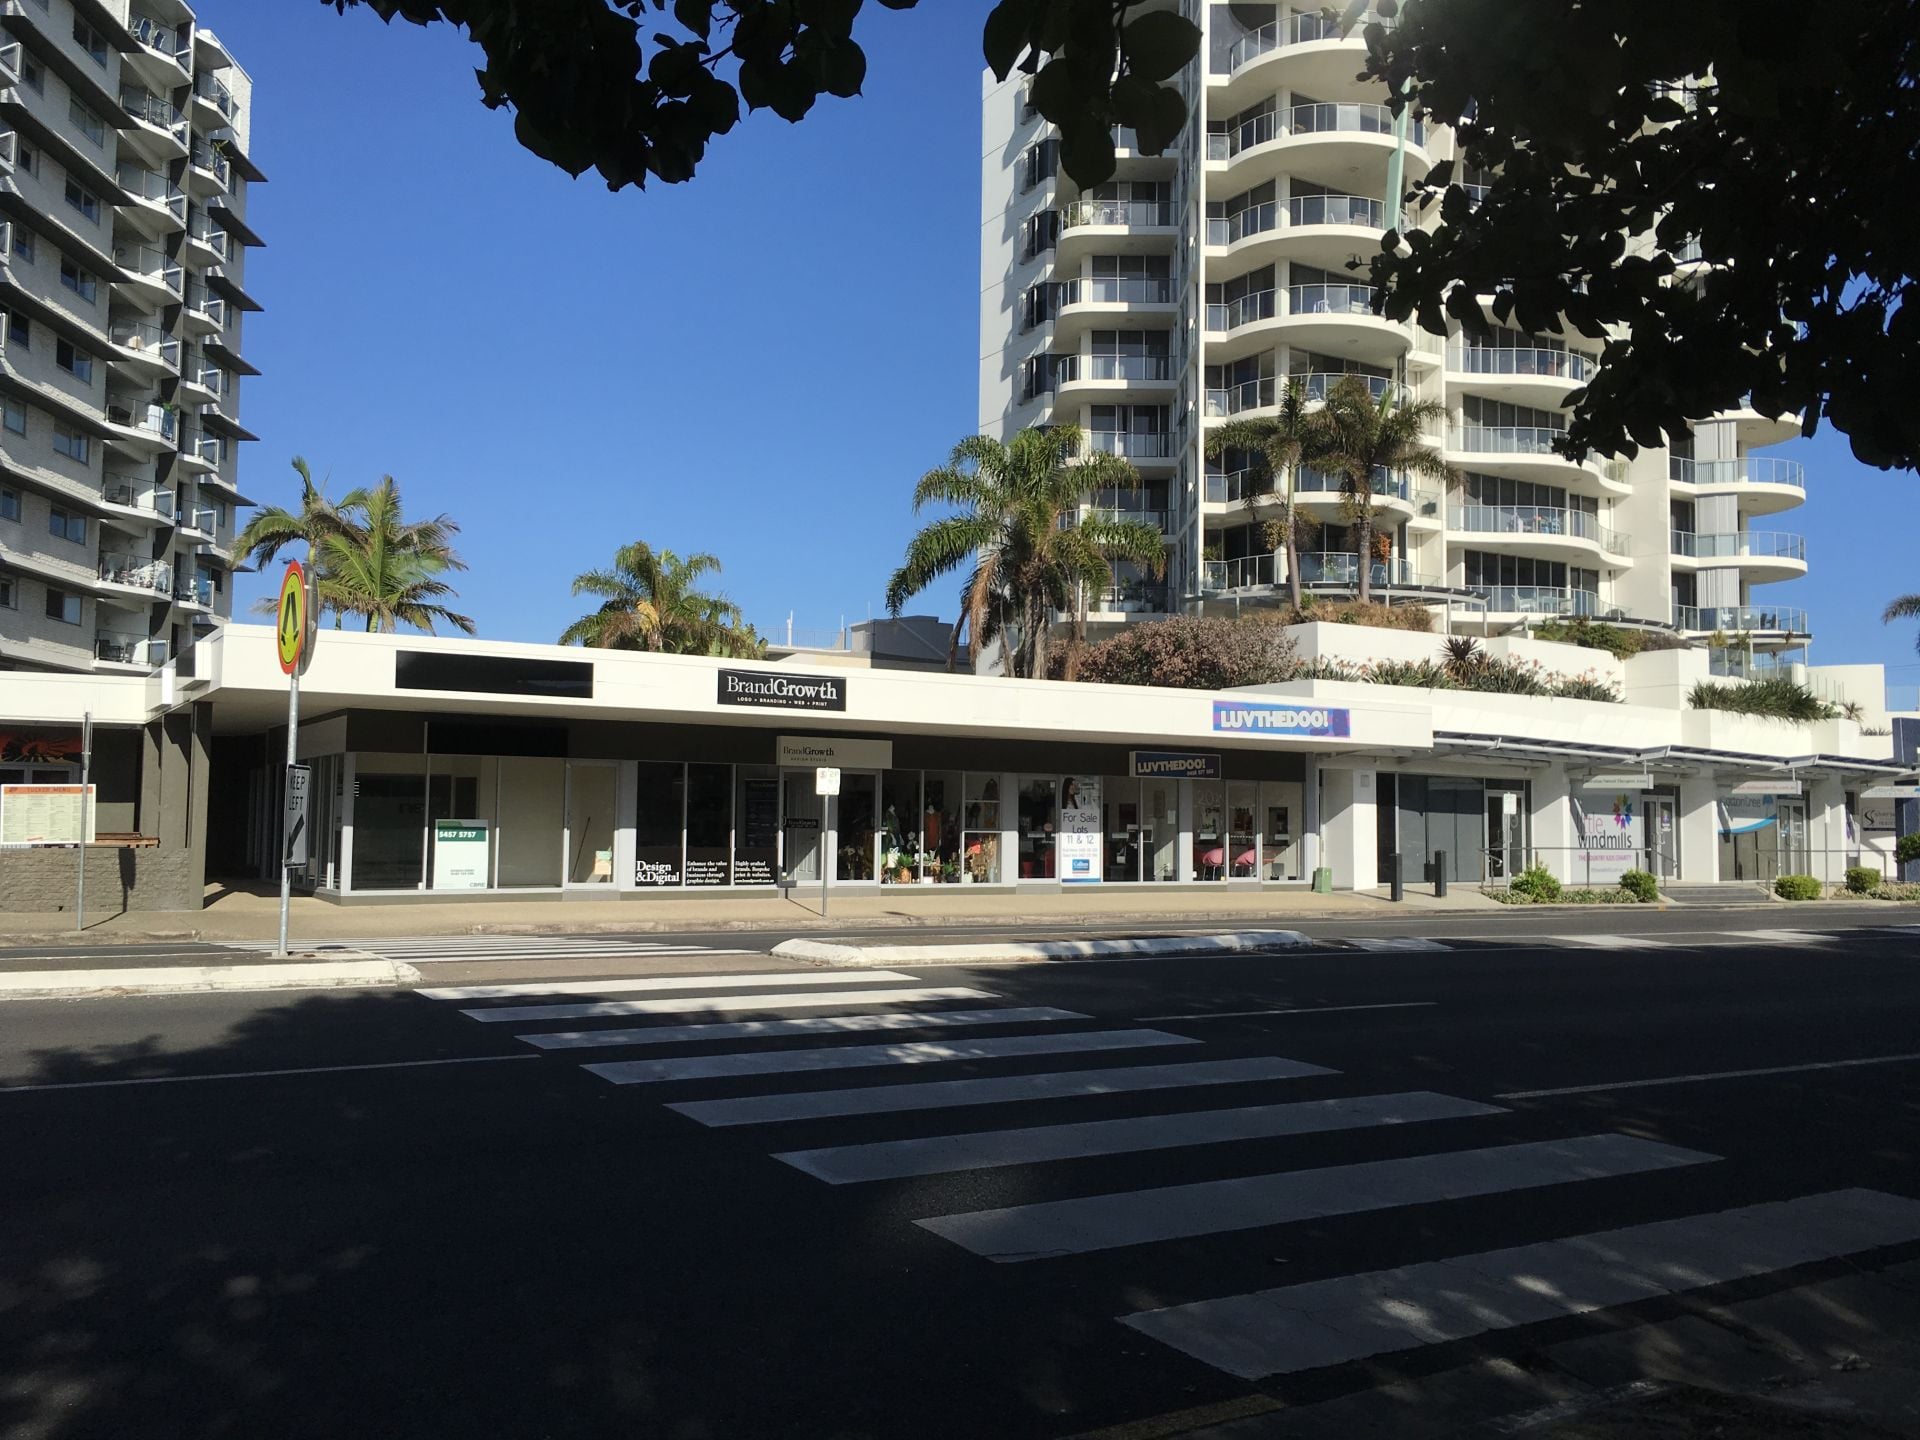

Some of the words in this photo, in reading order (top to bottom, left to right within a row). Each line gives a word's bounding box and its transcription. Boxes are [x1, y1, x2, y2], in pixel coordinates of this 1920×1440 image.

[727, 676, 837, 699] BrandGrowth
[1220, 709, 1329, 729] LUVTHEDOO!
[783, 746, 834, 756] BrandGrowth
[1137, 758, 1206, 773] LUVTHEDOO!
[290, 776, 305, 790] KEEP
[289, 796, 304, 811] LEFT
[1063, 812, 1076, 822] For
[1080, 812, 1098, 823] Sale
[1072, 825, 1089, 834] Lots
[1067, 835, 1073, 844] 11
[1076, 835, 1082, 844] &
[1086, 835, 1094, 845] 12
[1578, 829, 1632, 849] windmills
[636, 860, 672, 874] Design
[636, 871, 680, 885] &Digital
